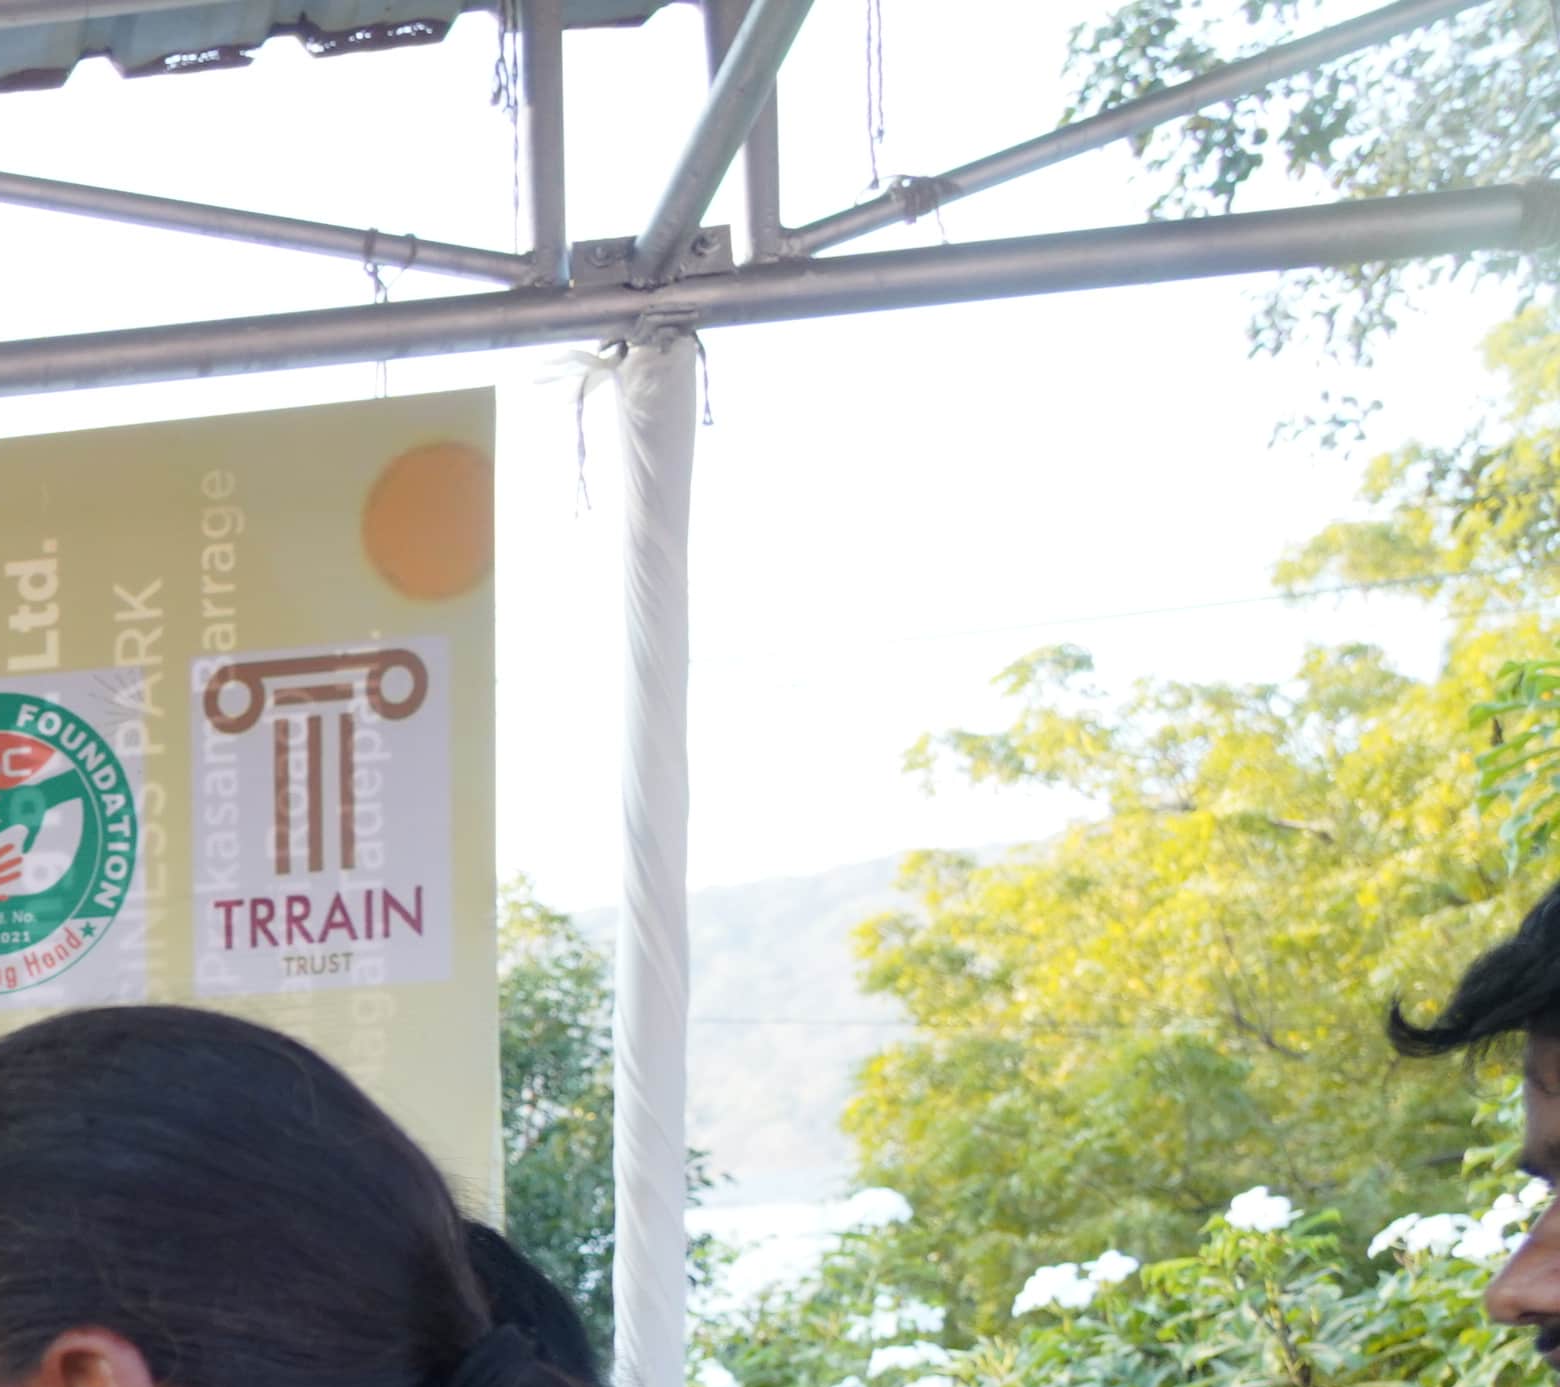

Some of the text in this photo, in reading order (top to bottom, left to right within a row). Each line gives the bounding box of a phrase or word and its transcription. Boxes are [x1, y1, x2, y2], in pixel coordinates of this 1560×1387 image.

[4, 538, 61, 670] Ltd.
[15, 702, 133, 911] FOUNDATION
[213, 884, 425, 951] TRRAIN
[282, 951, 356, 977] TRUST
